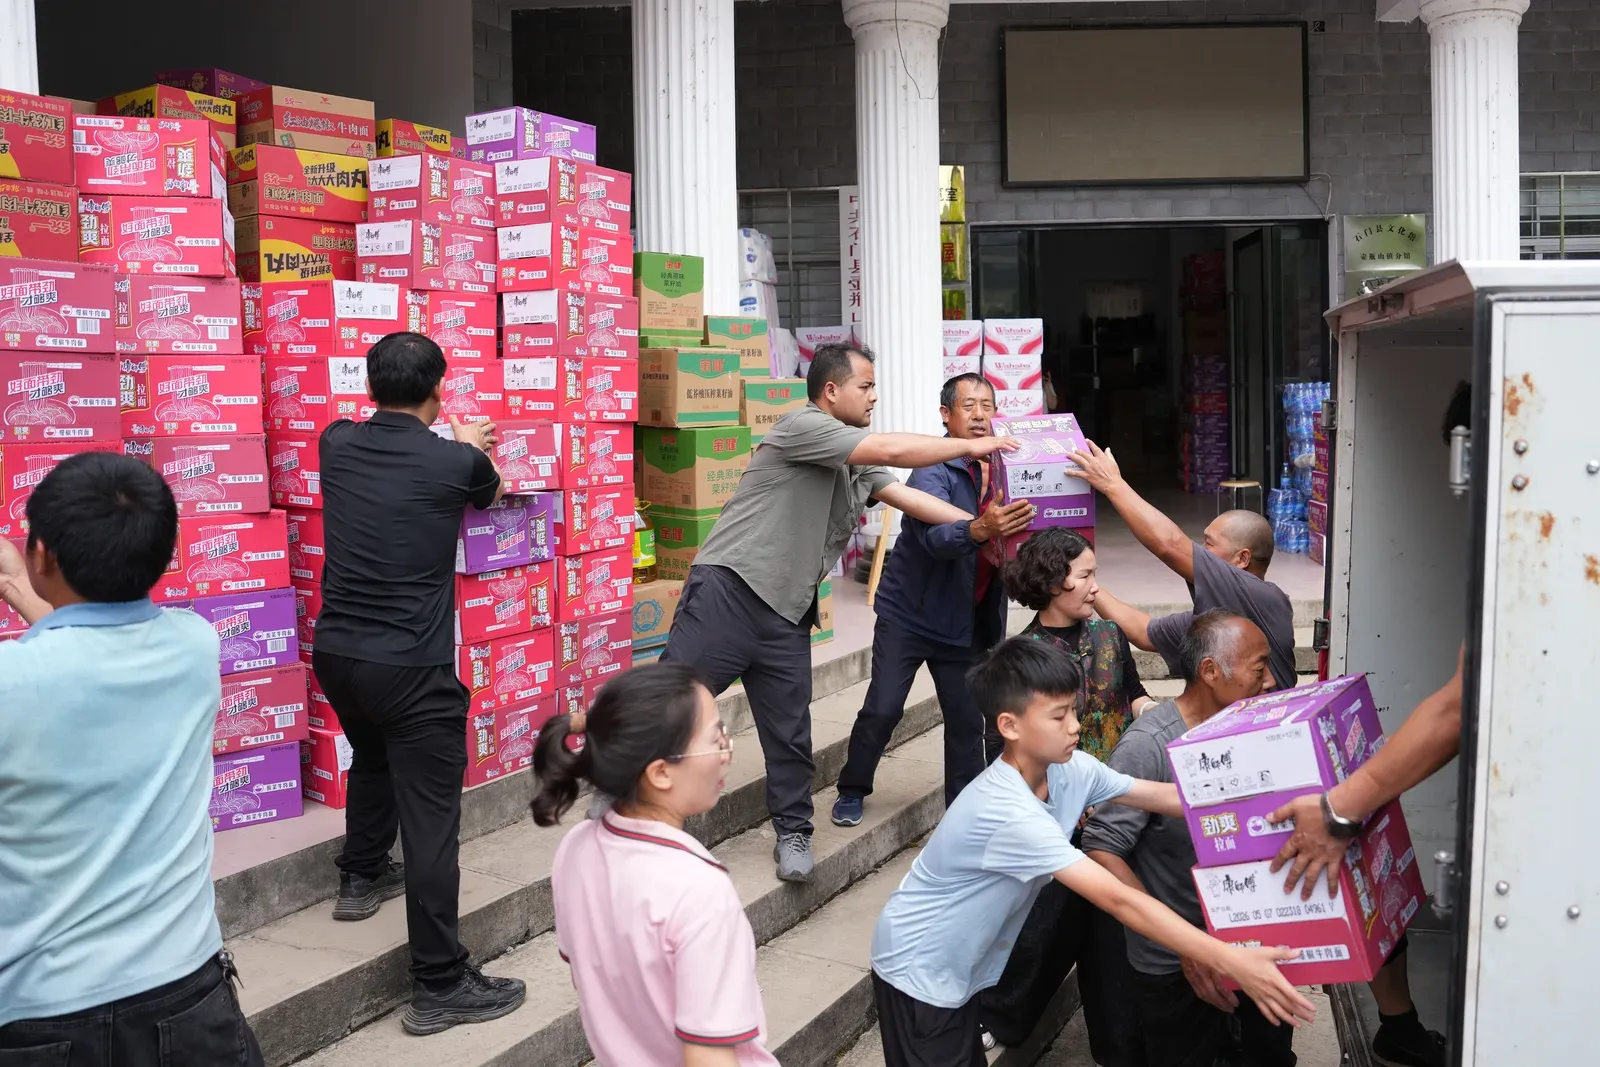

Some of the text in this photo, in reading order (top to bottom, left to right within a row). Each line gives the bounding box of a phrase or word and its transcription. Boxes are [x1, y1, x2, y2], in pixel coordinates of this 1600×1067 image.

[337, 121, 369, 136] 牛肉面
[525, 122, 535, 147] 劲爽
[545, 132, 570, 142] 好面带劲
[107, 158, 156, 177] 好面带劲
[177, 147, 193, 178] 劲爽
[304, 162, 335, 174] 全新升级
[430, 170, 441, 197] 劲爽
[559, 174, 569, 199] 劲爽
[580, 182, 606, 193] 好面带劲
[264, 186, 324, 205] 红烧牛肉面
[81, 214, 99, 246] 劲爽
[121, 215, 170, 234] 好面带劲
[140, 226, 172, 240] 才够爽
[1354, 224, 1417, 242] 石门县文化馆
[100, 223, 110, 246] 拉面
[423, 237, 433, 264] 劲爽
[562, 240, 571, 266] 劲爽
[1361, 252, 1411, 260] 壶瓶山镇分馆
[300, 265, 331, 278] 全新升级
[661, 272, 684, 280] 经典原味
[0, 280, 55, 300] 好面带劲
[21, 292, 57, 306] 才够爽
[140, 294, 188, 313] 好面带劲
[158, 303, 190, 318] 才够爽
[268, 298, 297, 317] 好面带劲
[119, 302, 127, 325] 拉面
[245, 300, 255, 329] 劲爽
[279, 307, 298, 322] 才够爽
[409, 305, 420, 332] 劲爽
[569, 306, 578, 332] 劲爽
[341, 327, 358, 339] 劲爽
[806, 334, 841, 342] Wahaha
[943, 328, 970, 336] ahaha
[995, 327, 1031, 336] Wahaha
[700, 359, 724, 372] 金健
[944, 362, 969, 373] 哈哈
[995, 362, 1031, 370] Wahaha
[9, 371, 63, 394] 好面带劲
[30, 383, 64, 399] 才够爽
[120, 375, 135, 406] 劲爽
[158, 374, 207, 395] 好面带劲
[177, 384, 209, 399] 才够爽
[271, 373, 297, 392] 好面带劲
[281, 383, 298, 397] 才够爽
[567, 372, 576, 398] 劲爽
[137, 384, 146, 406] 拉面
[686, 388, 733, 399] 低芥酸压榨菜籽油
[767, 388, 791, 399] 金健
[997, 397, 1032, 408] 娃哈哈
[572, 438, 580, 464] 劲爽
[713, 438, 737, 453] 金健
[164, 453, 212, 475] 好面带劲
[183, 463, 214, 479] 才够爽
[707, 468, 742, 482] 经典原味
[573, 505, 582, 530] 劲爽
[661, 526, 683, 542] 金健
[190, 532, 237, 556] 好面带劲
[208, 542, 239, 559] 才够爽
[567, 570, 576, 597] 劲爽
[221, 622, 250, 639] 才够爽
[562, 636, 572, 662] 劲爽
[473, 661, 484, 688] 劲爽
[220, 687, 256, 708] 面带劲
[227, 698, 258, 716] 才够爽
[477, 729, 488, 757] 劲爽
[214, 765, 249, 787] 面带劲
[219, 776, 250, 795] 才够爽
[1201, 813, 1239, 836] 劲爽
[1214, 836, 1236, 852] 拉面
[1229, 911, 1250, 923] L2026
[1252, 910, 1262, 920] 05
[1264, 908, 1272, 918] 07
[1276, 905, 1302, 917] 022318
[1304, 903, 1326, 914] 04961
